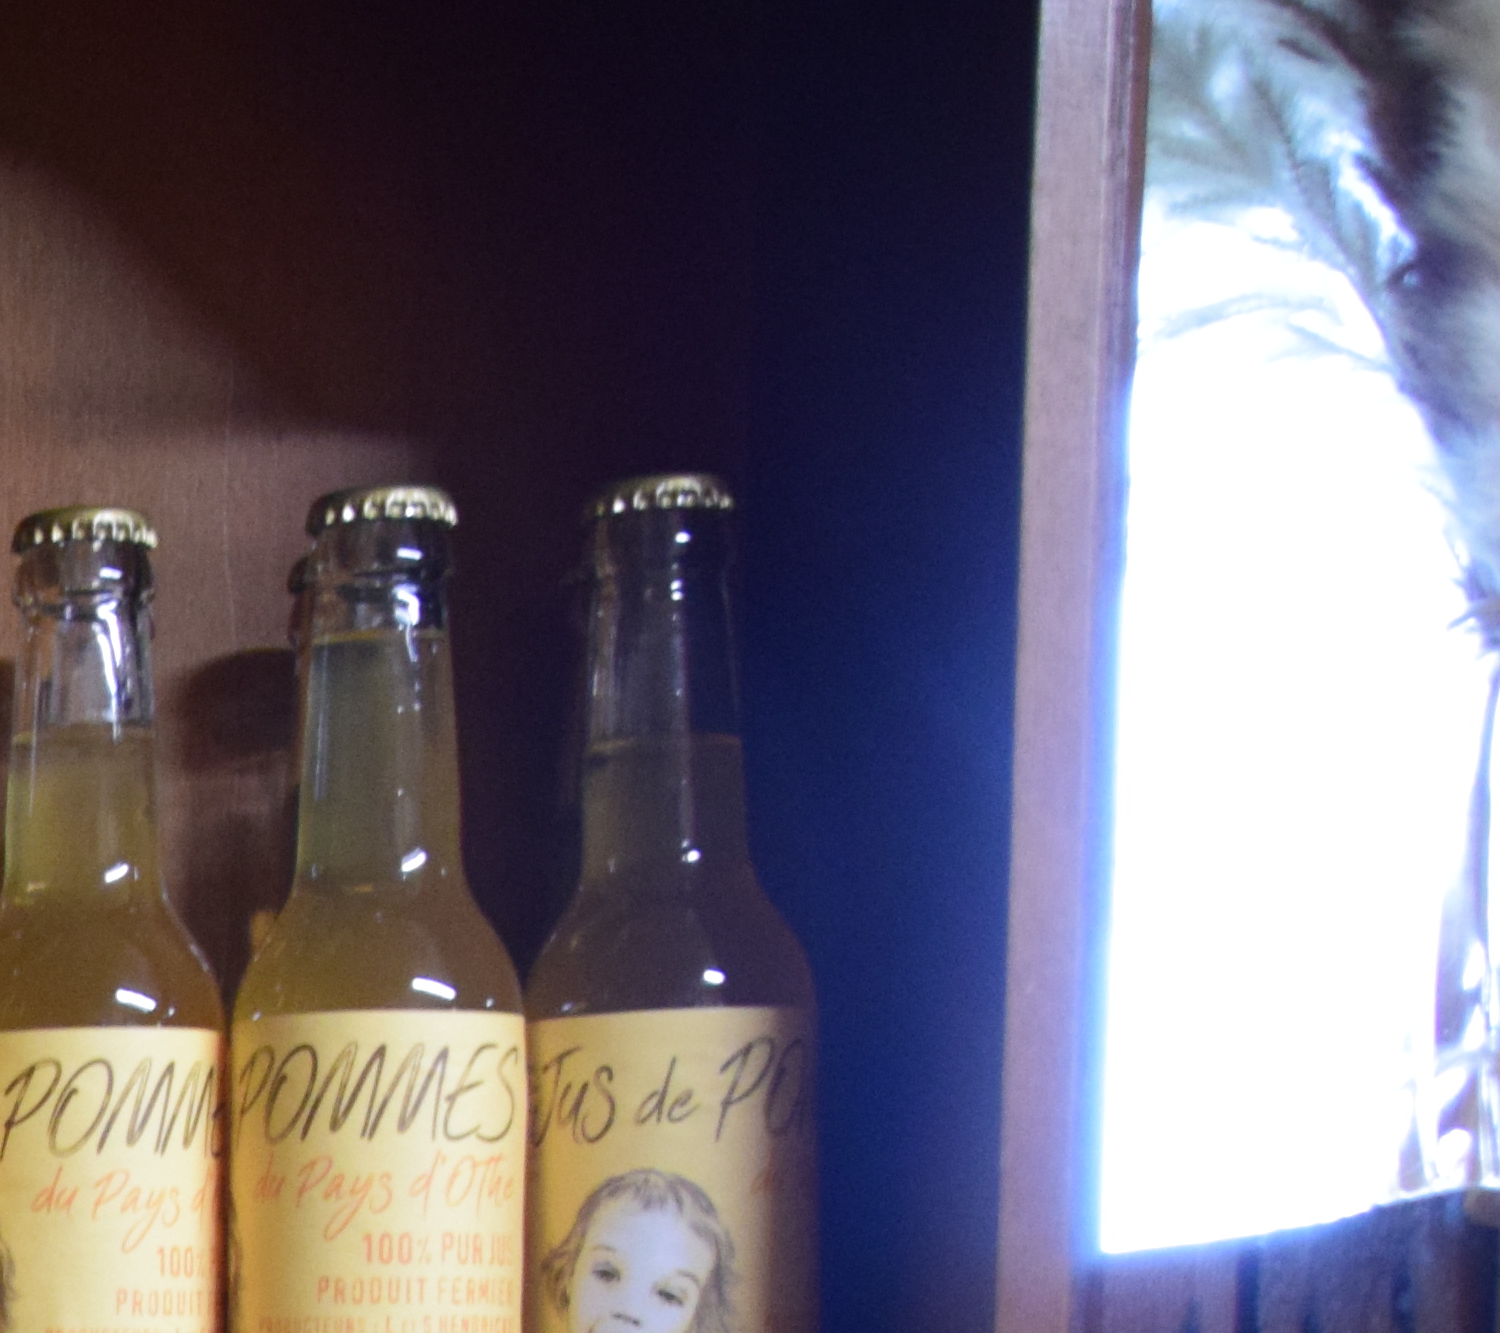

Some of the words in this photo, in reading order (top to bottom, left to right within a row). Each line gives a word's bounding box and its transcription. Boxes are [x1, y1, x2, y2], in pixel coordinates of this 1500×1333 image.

[236, 1041, 519, 1150] POMMES
[530, 1046, 616, 1149] Jus
[634, 1057, 699, 1126] de
[31, 1166, 79, 1219] du
[92, 1168, 180, 1254] Pays
[256, 1154, 285, 1201] du
[296, 1154, 393, 1241] Pays
[317, 1276, 428, 1305] PRODUIT
[437, 1276, 513, 1306] FERMIER
[362, 1232, 432, 1266] 100%
[441, 1232, 483, 1266] PUR
[116, 1288, 204, 1316] PRODUIT
